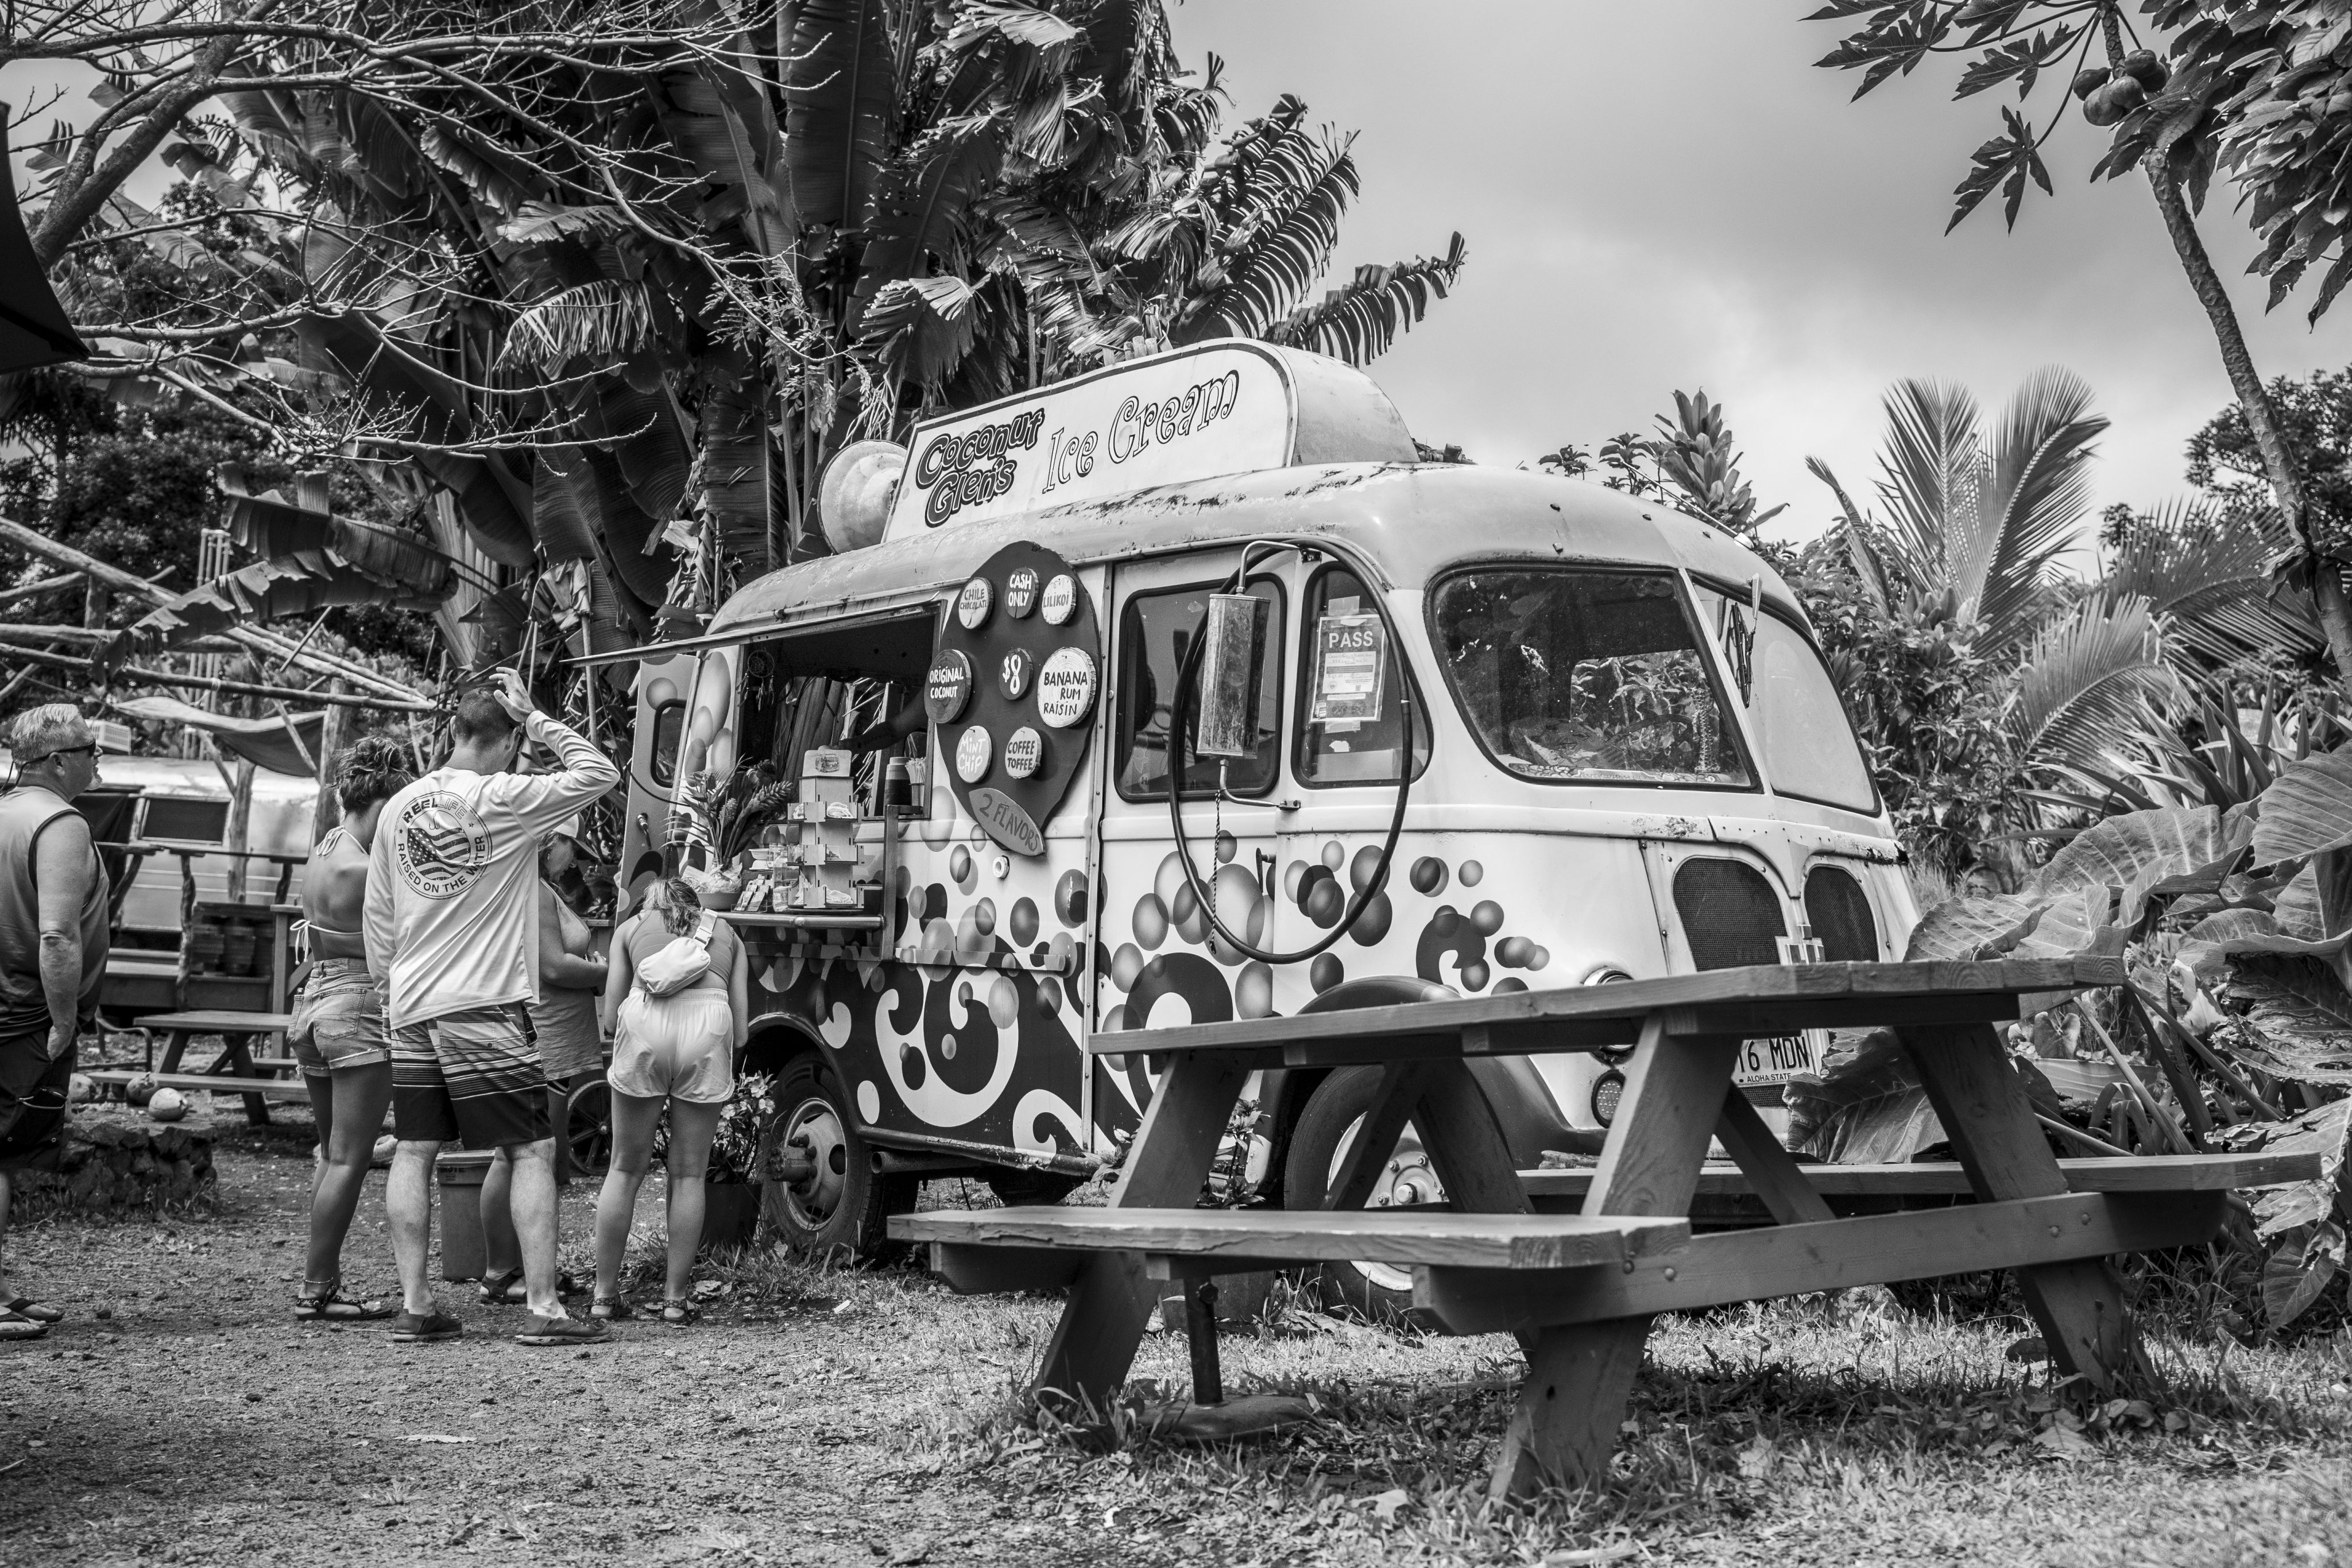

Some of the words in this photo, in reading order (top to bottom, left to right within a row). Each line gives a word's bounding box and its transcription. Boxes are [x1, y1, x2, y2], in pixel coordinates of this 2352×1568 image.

[1042, 427, 1098, 494] Ice
[1108, 369, 1240, 464] Cream
[924, 455, 1018, 528] Glen's
[1009, 574, 1032, 590] CASH
[1008, 591, 1029, 606] ONLY
[1329, 631, 1373, 648] PASS
[1002, 654, 1022, 695] $8
[1044, 671, 1088, 686] BANANA
[930, 686, 958, 699] COCONUT
[1060, 687, 1081, 700] RUM
[1008, 740, 1035, 755] COFFEE
[1008, 758, 1032, 771] TOFFEE
[980, 793, 992, 817] 2
[993, 803, 1039, 851] FLAVORS
[398, 843, 421, 885] RAISED
[424, 882, 439, 893] ON
[443, 876, 467, 892] THE
[466, 835, 485, 876] WATER
[1769, 1036, 1809, 1070] MDN
